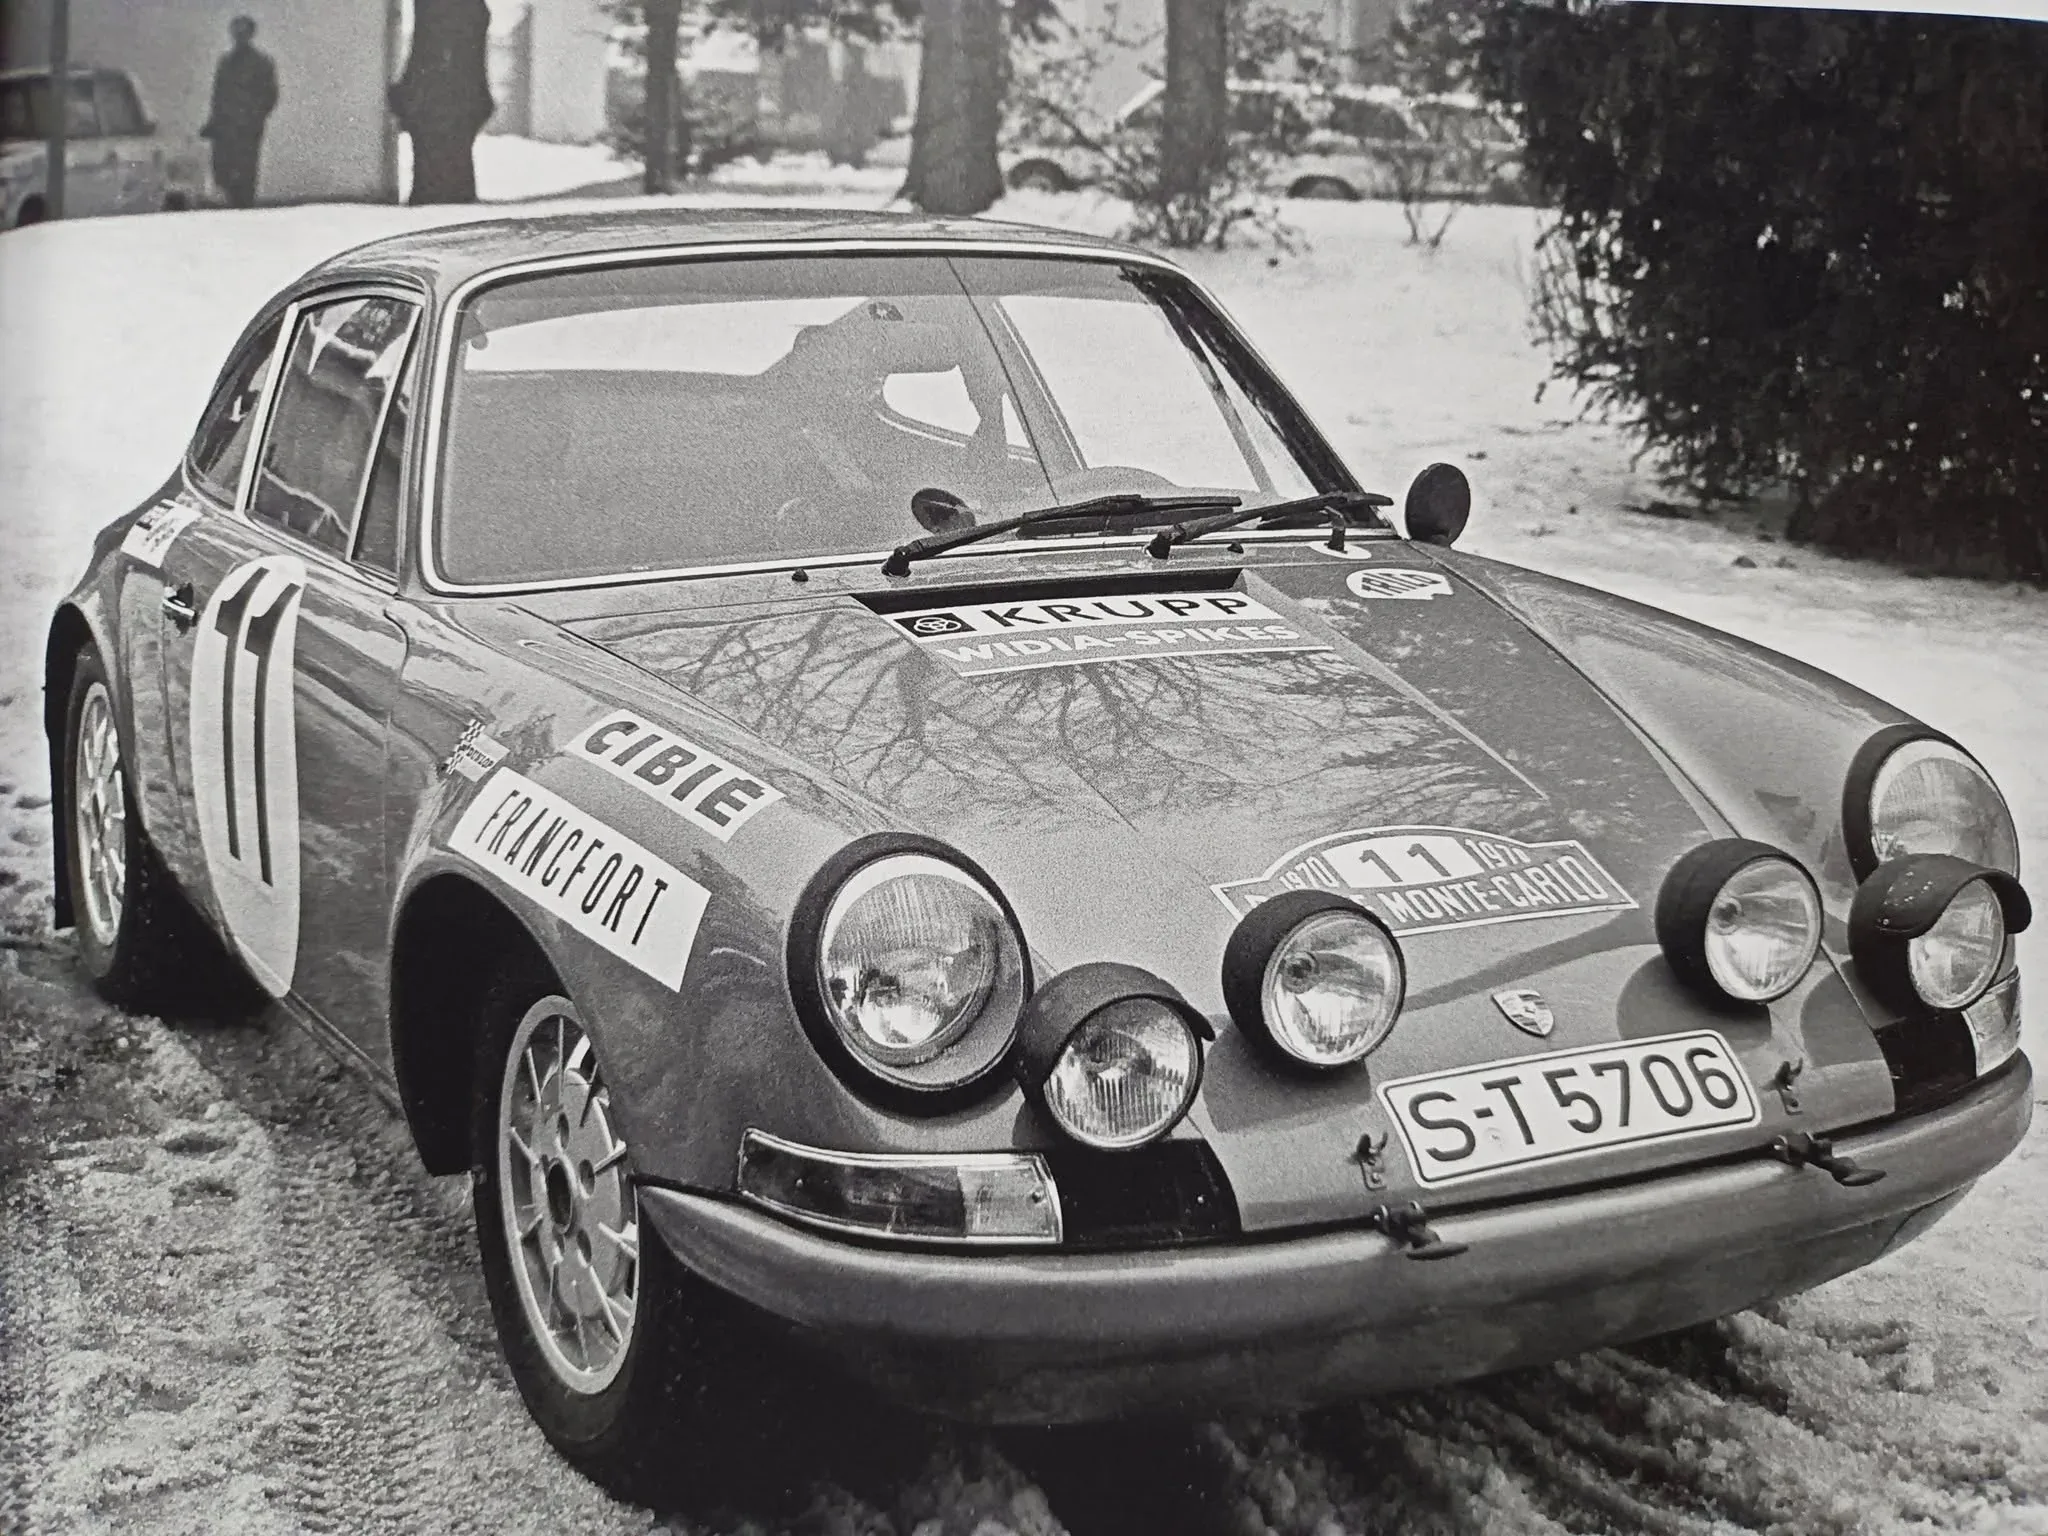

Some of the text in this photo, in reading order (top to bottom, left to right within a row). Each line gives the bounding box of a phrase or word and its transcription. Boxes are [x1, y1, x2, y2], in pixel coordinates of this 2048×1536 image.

[982, 597, 1250, 628] KRUPP
[934, 624, 1301, 663] WIDIA-SPIKES
[215, 567, 301, 888] 11
[474, 789, 669, 946] FRANCFORT
[1358, 842, 1452, 883] 11
[1464, 838, 1532, 871] 1970
[1384, 854, 1609, 924] MONTE-CARLO
[1408, 1046, 1739, 1163] S-T 5706
